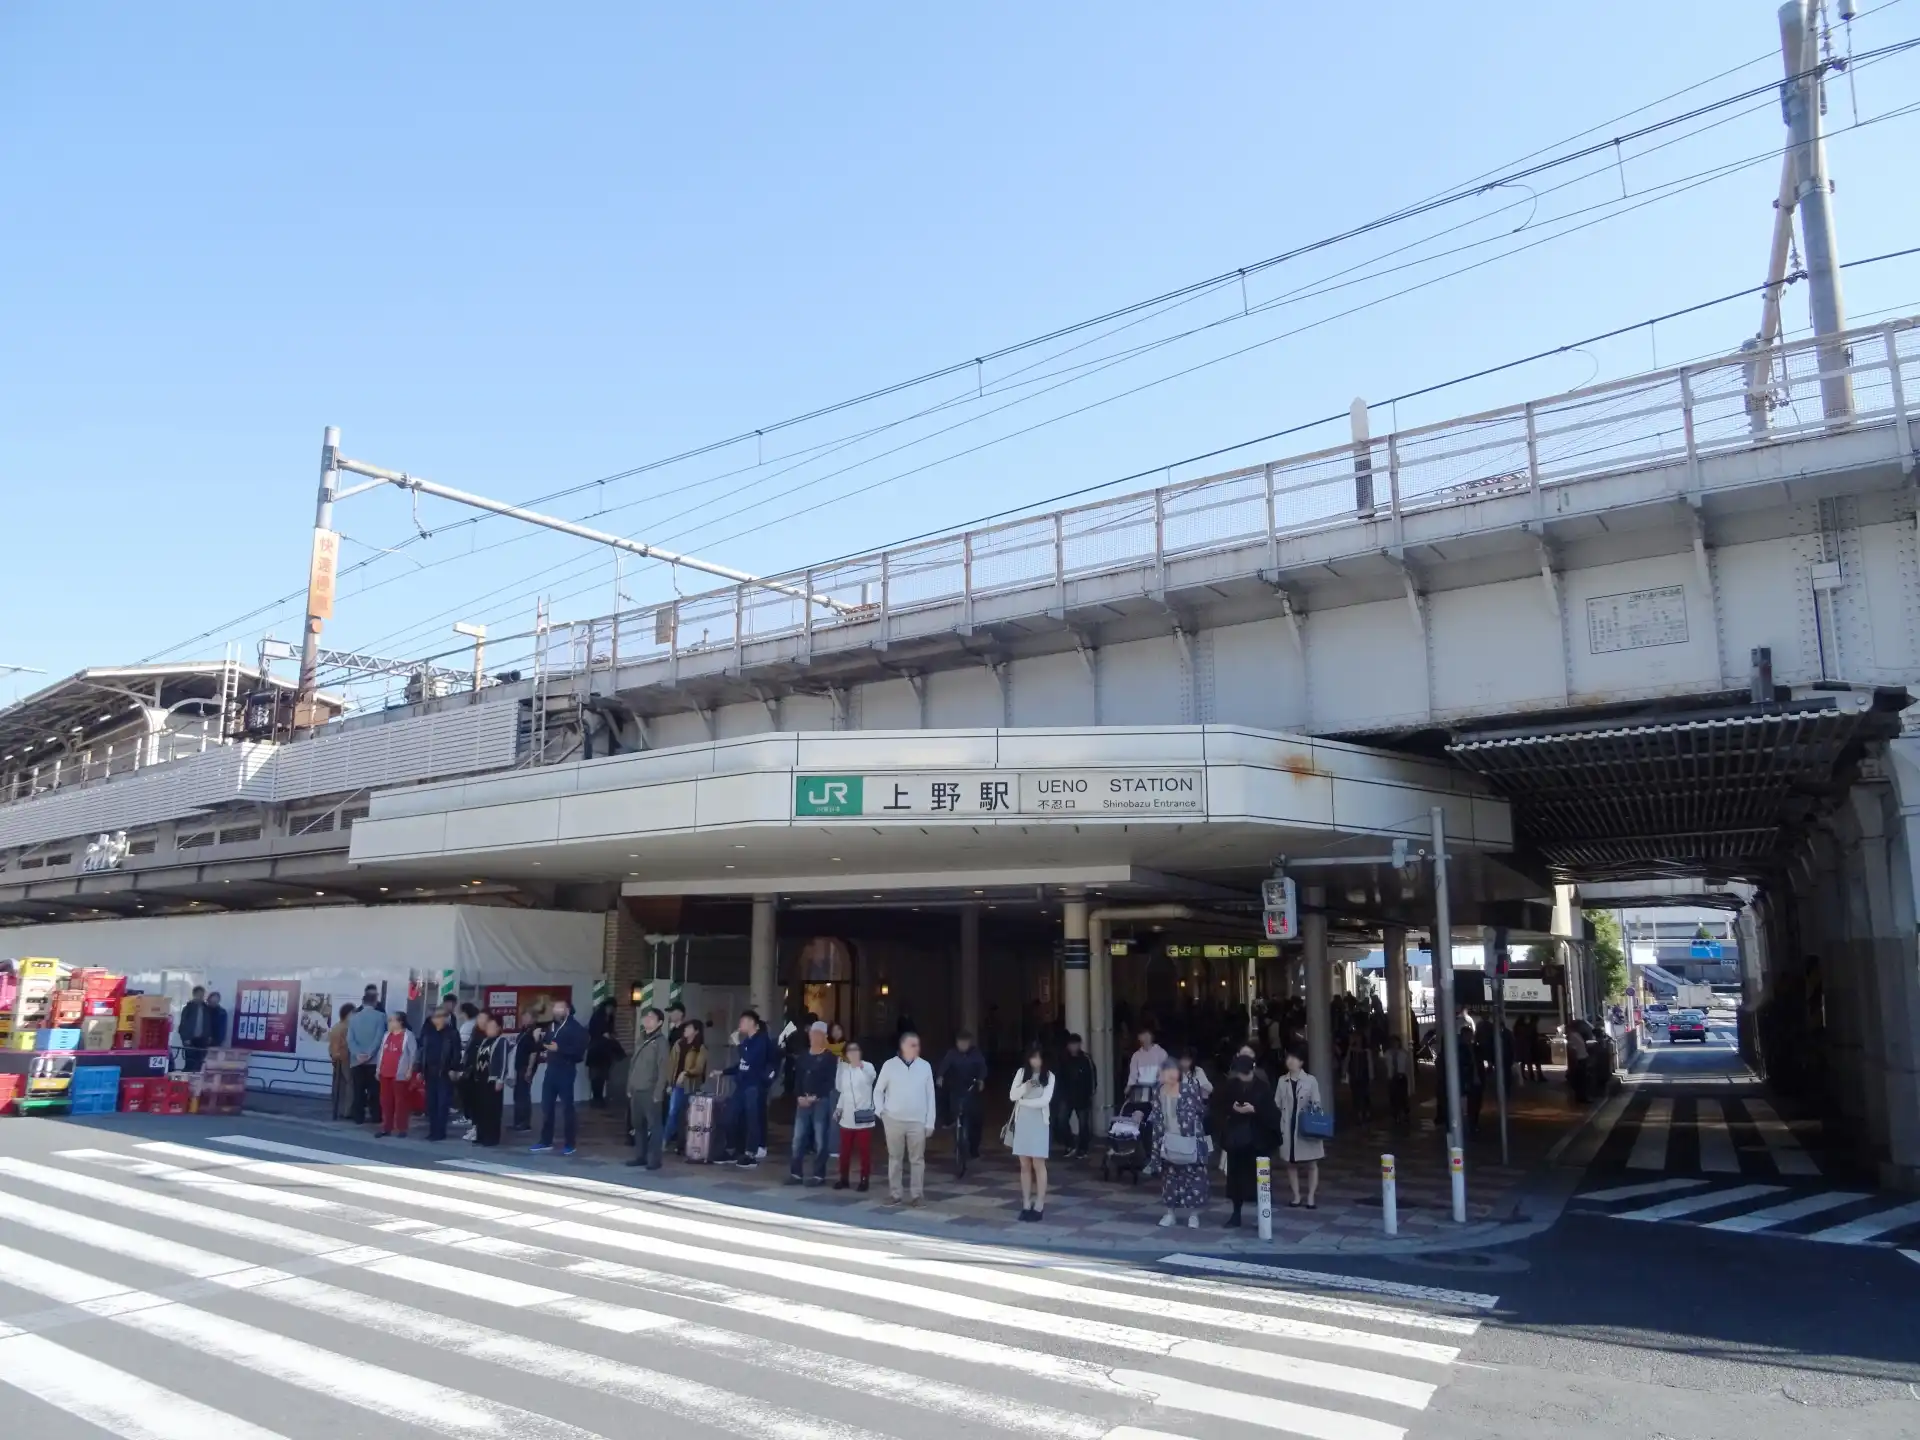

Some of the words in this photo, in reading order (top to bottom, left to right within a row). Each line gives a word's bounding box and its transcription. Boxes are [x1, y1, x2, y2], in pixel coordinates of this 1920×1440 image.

[1037, 779, 1088, 794] UENO
[1109, 777, 1194, 793] STATION
[808, 782, 848, 804] JR
[883, 782, 1010, 811] 上野駅
[1037, 799, 1077, 810] 不忍口
[1102, 799, 1151, 809] Shinobazu
[1153, 797, 1197, 809] Entrance
[151, 1057, 164, 1067] 24
